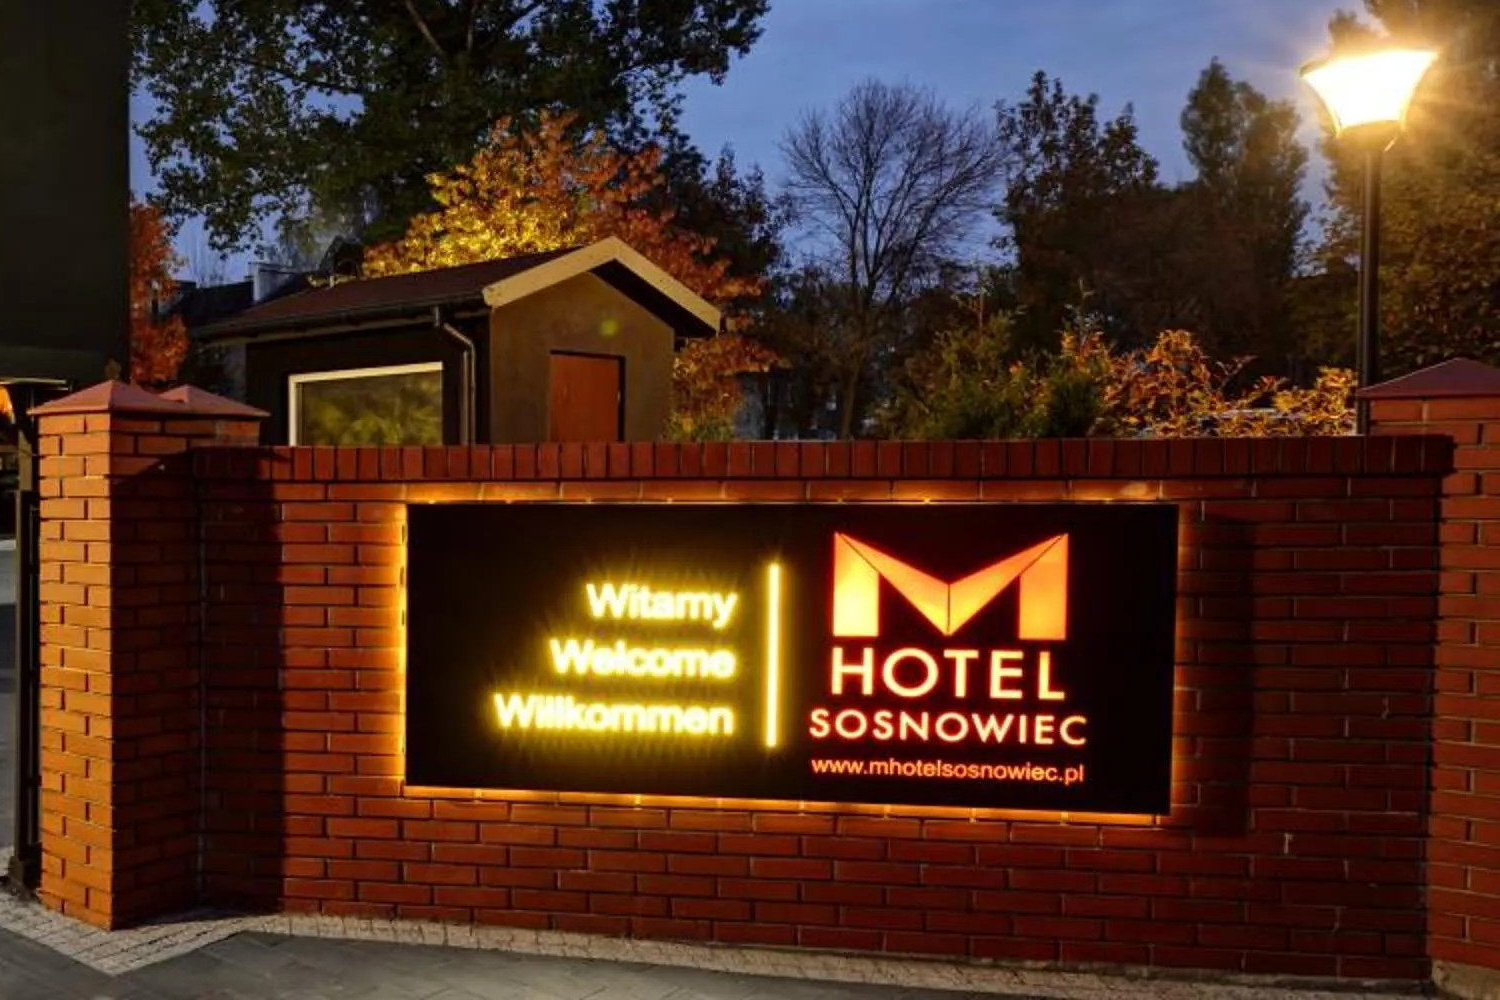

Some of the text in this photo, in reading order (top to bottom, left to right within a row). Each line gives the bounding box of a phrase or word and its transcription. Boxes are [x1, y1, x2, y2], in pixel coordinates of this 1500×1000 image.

[585, 582, 739, 630] Witamy
[833, 532, 1069, 641] M
[549, 638, 737, 679] Welcome
[831, 647, 1066, 700] HOTEL
[492, 692, 735, 735] Willkommen
[808, 708, 1088, 746] SOSNOWIEC
[811, 757, 1085, 785] www.mhotelsosnowiec.pl
